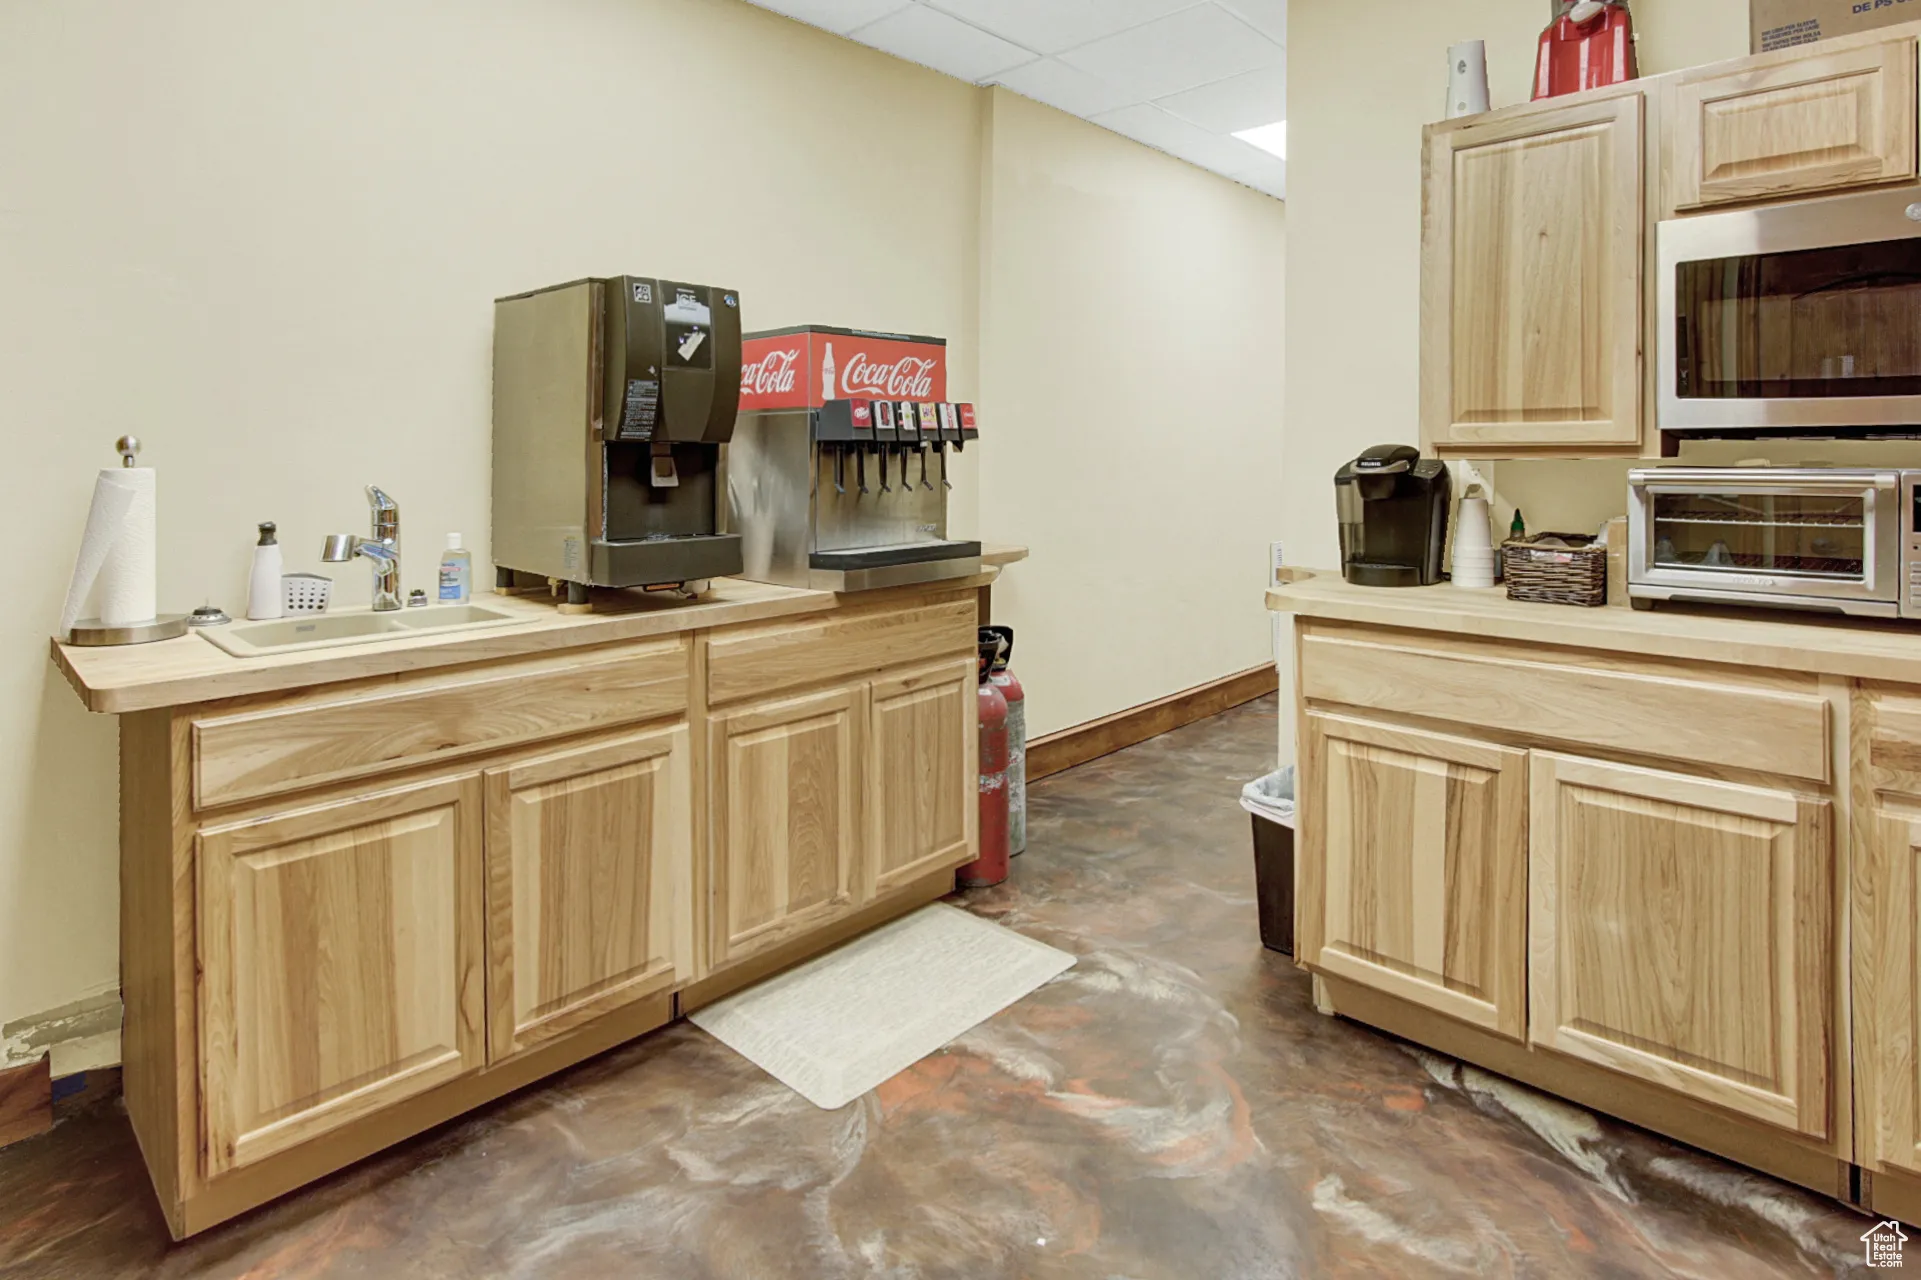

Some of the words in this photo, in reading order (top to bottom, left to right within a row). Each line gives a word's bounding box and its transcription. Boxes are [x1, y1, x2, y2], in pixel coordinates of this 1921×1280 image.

[1852, 2, 1872, 14] DE
[676, 293, 698, 307] ICE
[740, 349, 799, 394] ca-Cola
[841, 353, 937, 397] Coca-Cola
